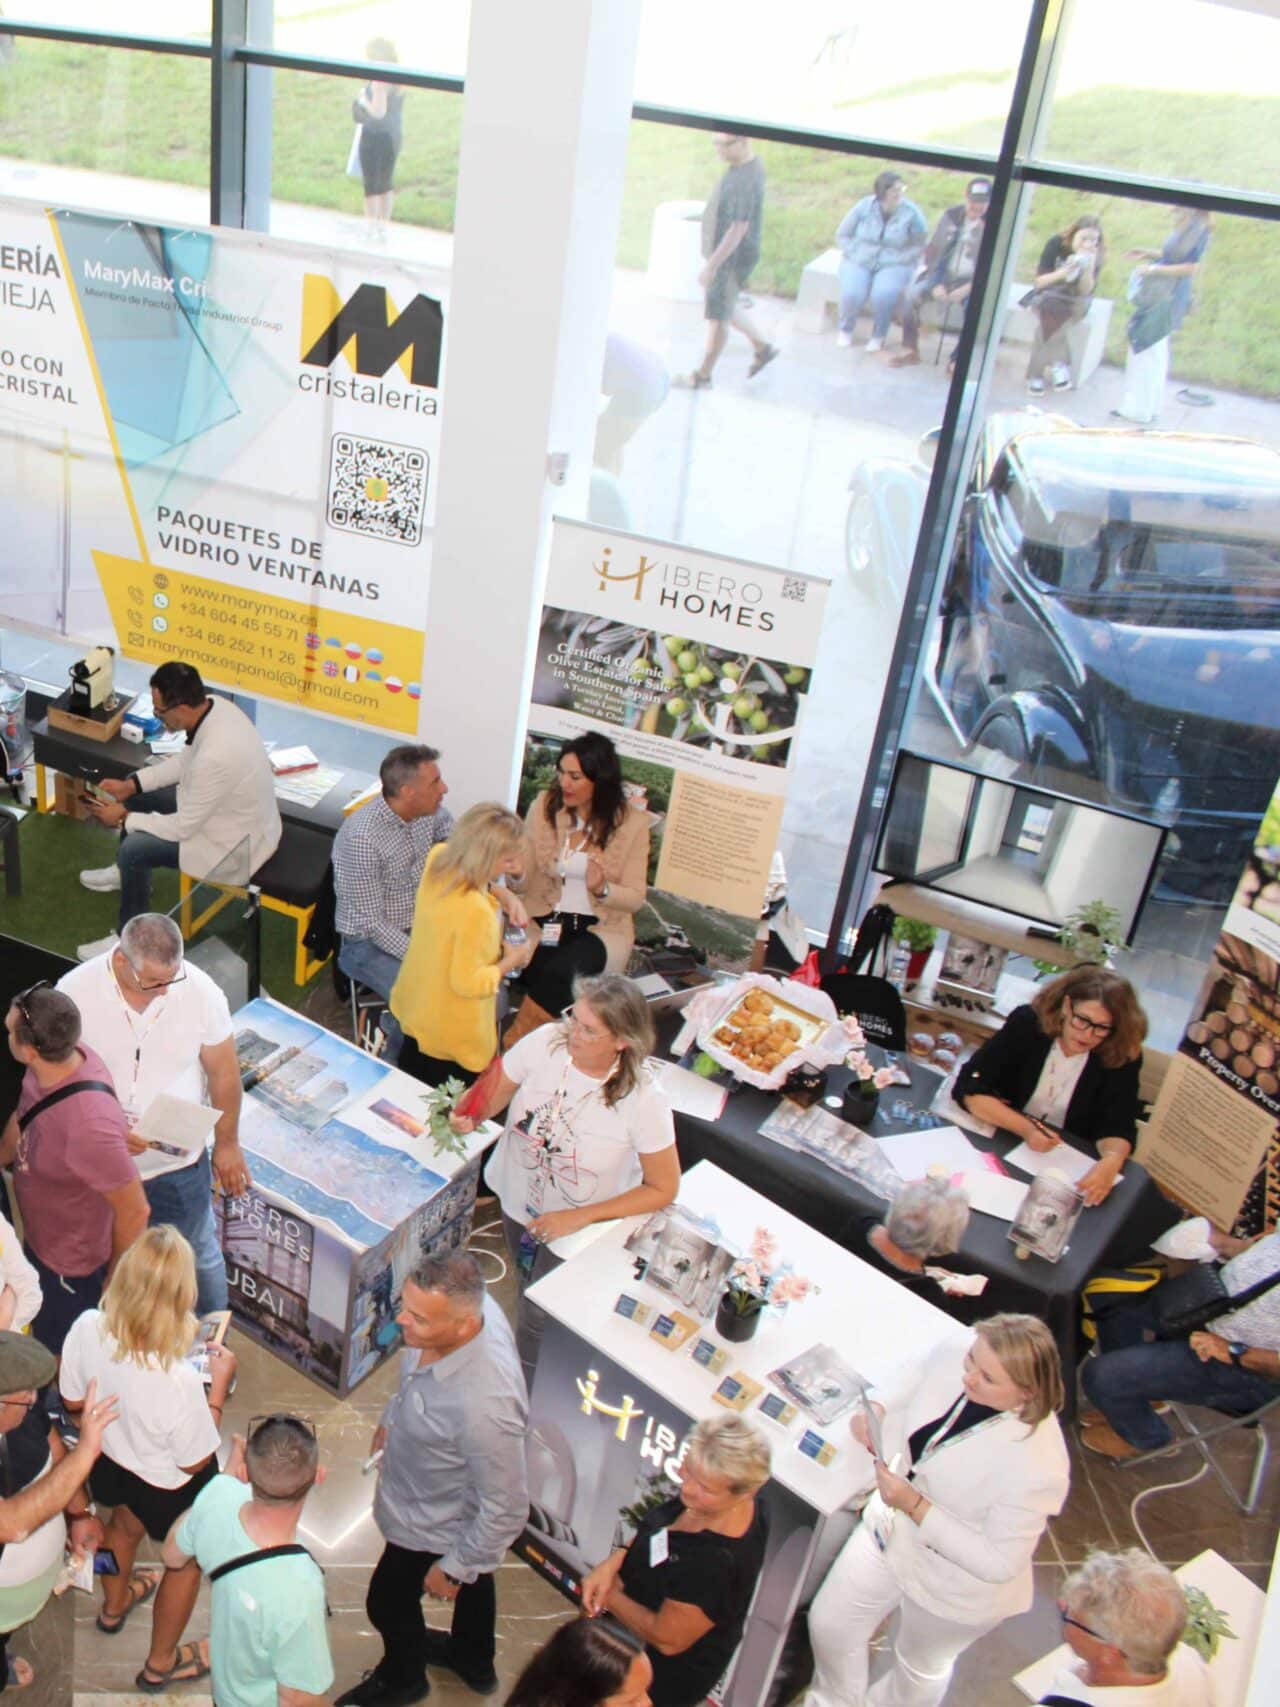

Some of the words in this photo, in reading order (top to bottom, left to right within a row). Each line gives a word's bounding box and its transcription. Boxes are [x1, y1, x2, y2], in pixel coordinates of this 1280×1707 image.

[83, 259, 175, 293] MaryMax
[179, 276, 208, 298] Cri
[251, 316, 284, 333] Group
[20, 353, 65, 377] CON
[297, 371, 439, 417] cristaleria
[157, 506, 282, 551] PAQUETES
[291, 537, 323, 560] DE
[158, 532, 240, 567] VIDRIO
[248, 553, 380, 601] VENTANAS
[663, 563, 763, 604] IBERO
[180, 583, 318, 628] www.marymax.es
[180, 602, 206, 618] +34
[241, 616, 260, 633] 45
[263, 622, 282, 639] 55
[659, 587, 775, 632] HOMES
[178, 625, 204, 641] +34
[229, 637, 255, 655] 252
[278, 650, 296, 666] 26
[557, 643, 611, 665] Certified
[146, 636, 380, 709] marymax.espanol@gmail.com
[547, 653, 580, 669] Olive
[583, 661, 625, 681] Estate
[625, 673, 642, 687] for
[645, 679, 671, 693] Sale
[553, 668, 566, 680] in
[568, 670, 624, 695] Southern
[624, 686, 661, 704] Spain
[1199, 1046, 1248, 1091] Property
[1249, 1084, 1280, 1113] Over
[231, 1200, 311, 1263] HOMES
[239, 1193, 300, 1238] BERO
[226, 1268, 284, 1318] UBAI
[640, 1436, 684, 1484] HO
[645, 1416, 691, 1462] IBE
